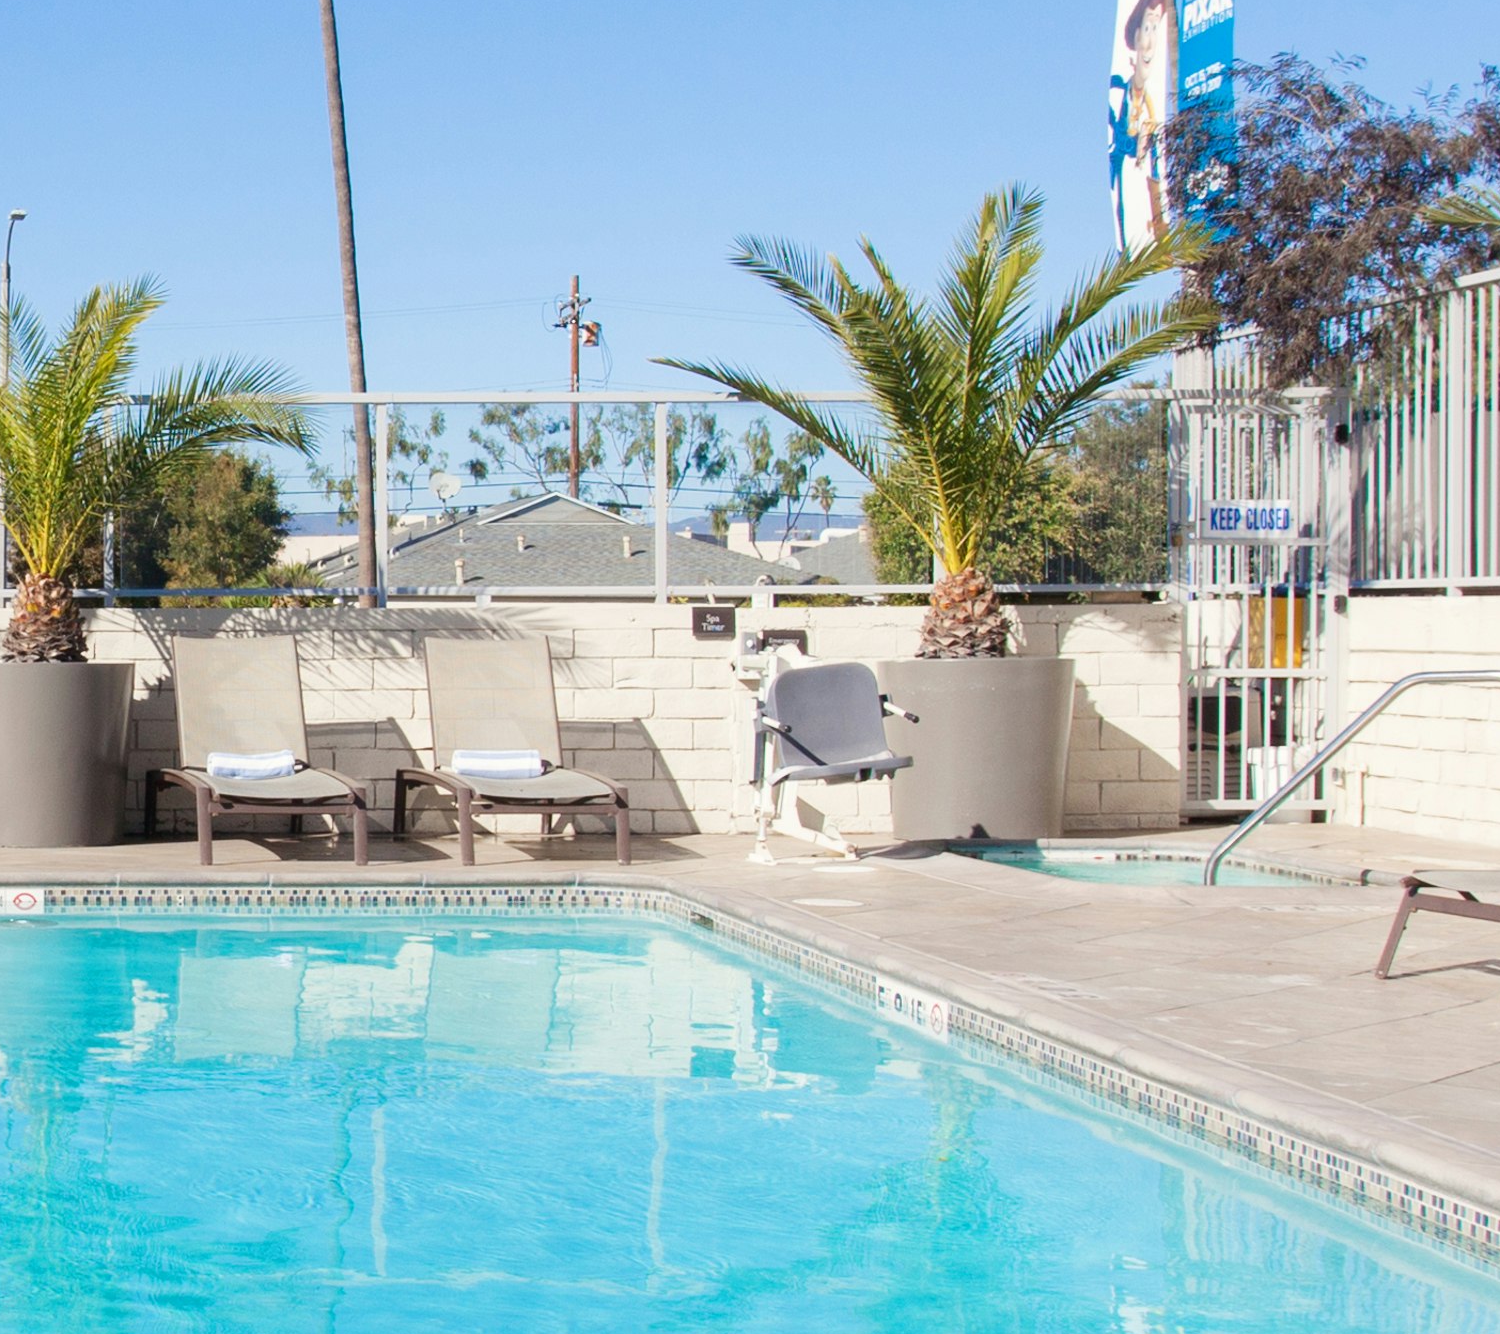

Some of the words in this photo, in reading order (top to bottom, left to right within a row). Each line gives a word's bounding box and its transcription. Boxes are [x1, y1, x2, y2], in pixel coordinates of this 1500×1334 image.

[1182, 9, 1234, 43] EXHIBITION
[1210, 507, 1241, 531] KEEP
[1246, 507, 1290, 531] CLOSED
[705, 614, 720, 623] Spa
[702, 623, 725, 631] Timer
[768, 637, 800, 645] Emergency
